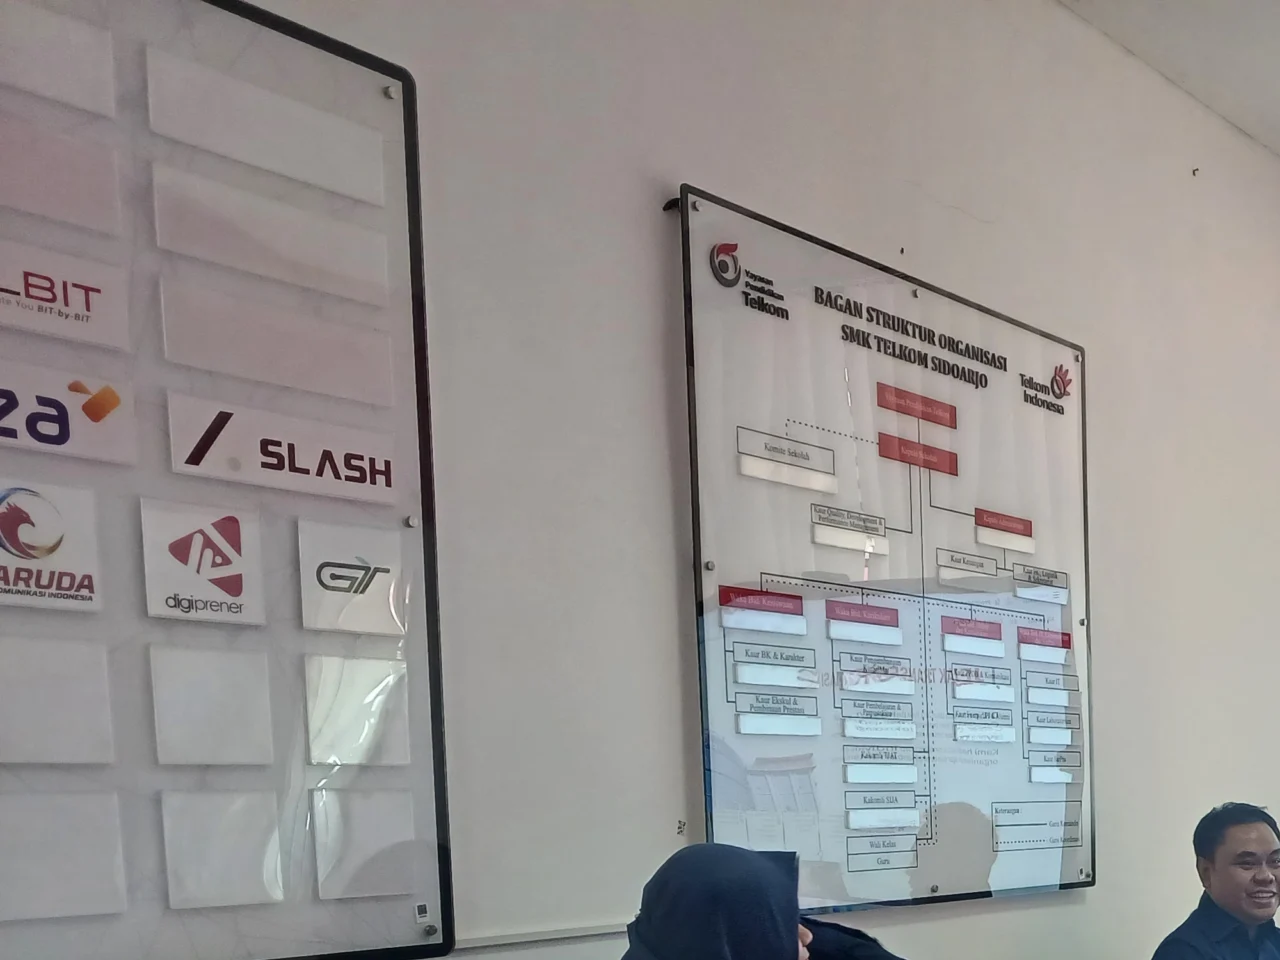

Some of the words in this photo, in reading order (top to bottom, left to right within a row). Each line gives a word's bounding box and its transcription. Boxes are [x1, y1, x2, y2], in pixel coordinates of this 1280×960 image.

[744, 268, 774, 286] Yayasan
[37, 304, 91, 323] BIT-by-BIT
[741, 291, 789, 320] Telkom
[813, 286, 864, 319] BAGAN
[866, 306, 937, 347] STRUKTUR
[938, 333, 1008, 372] ORGANISASI
[841, 324, 872, 350] SMK
[874, 336, 928, 369] TELKOM
[931, 356, 988, 389] SIDOARJO
[1019, 373, 1050, 395] Telkom
[1023, 389, 1065, 415] Indonesia
[764, 442, 785, 454] Komite
[787, 447, 810, 461] Sekolah
[259, 438, 392, 487] SLASH
[48, 592, 93, 602] INDONESIA
[165, 593, 244, 614] digiprener
[745, 649, 759, 658] Kaur
[761, 651, 771, 659] BK
[780, 652, 805, 662] Karakter
